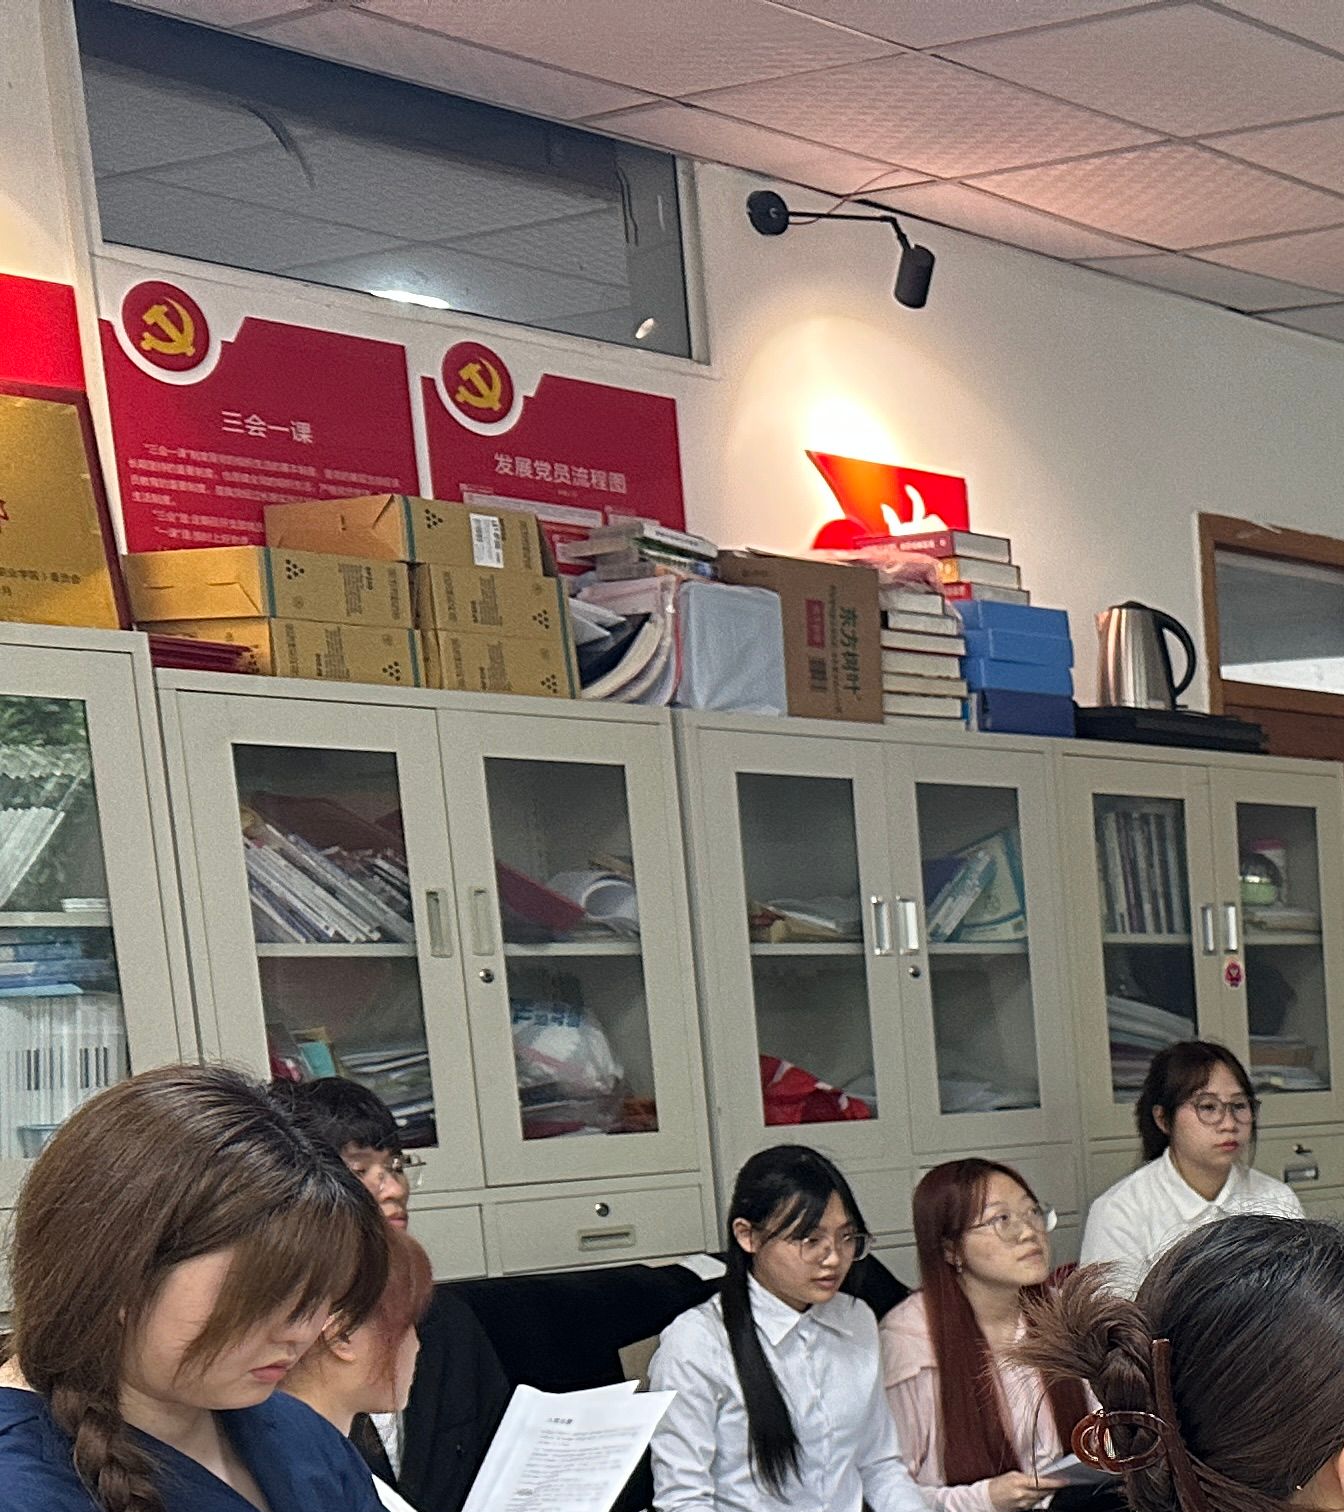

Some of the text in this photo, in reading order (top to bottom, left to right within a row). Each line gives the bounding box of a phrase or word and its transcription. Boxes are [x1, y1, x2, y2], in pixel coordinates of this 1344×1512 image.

[220, 410, 314, 445] 三会一课
[493, 452, 628, 495] 发展党员流程图
[840, 606, 861, 696] 东方树叶
